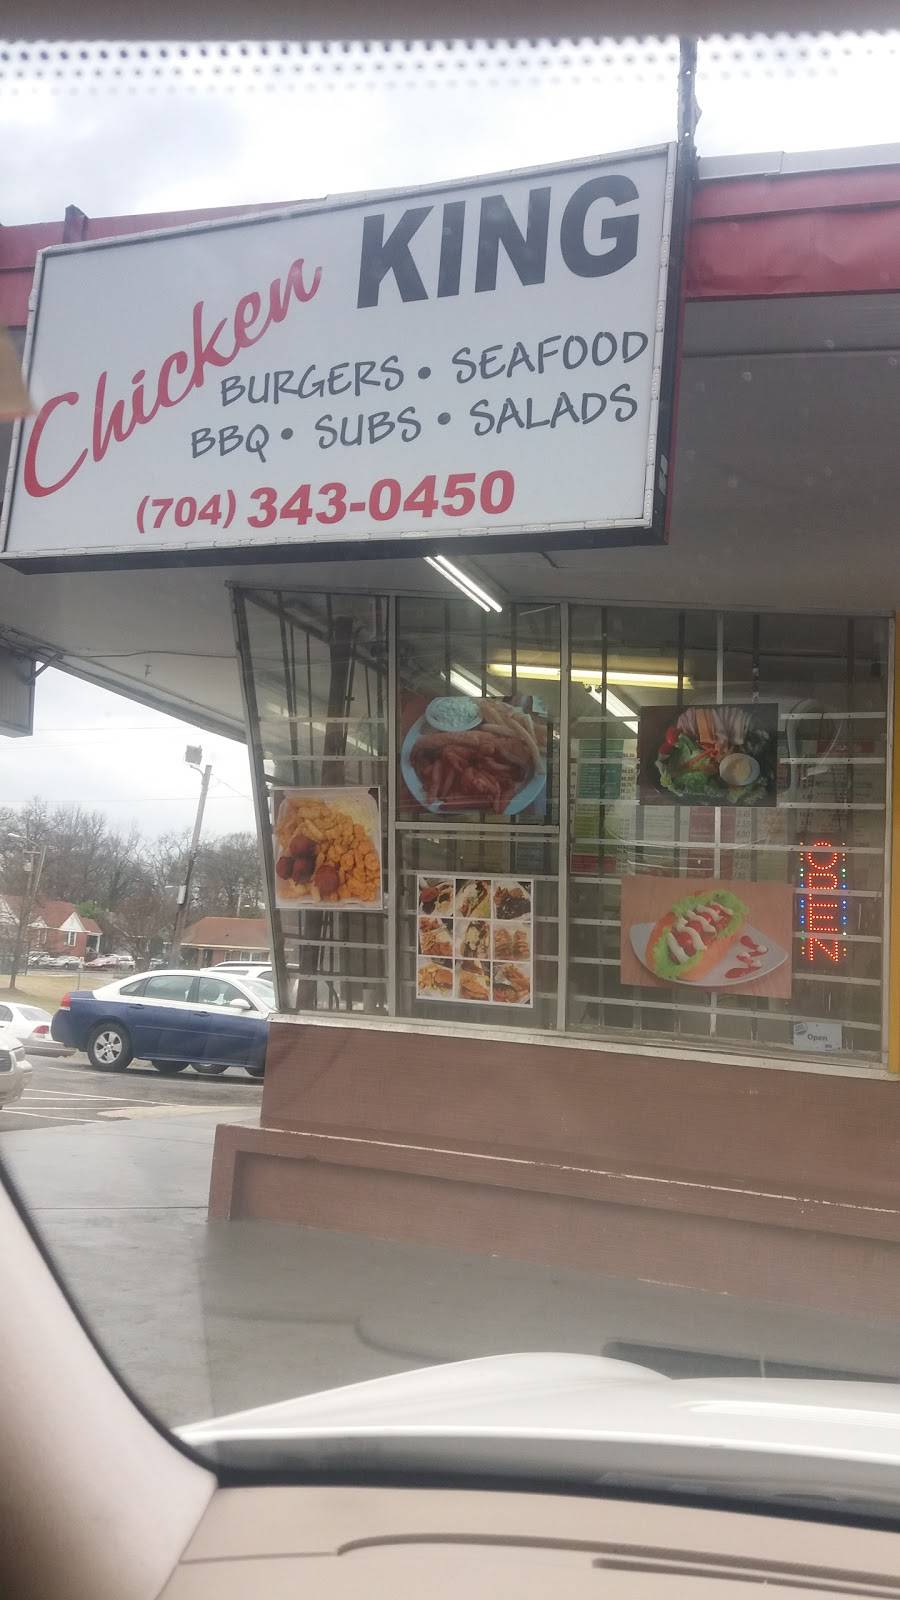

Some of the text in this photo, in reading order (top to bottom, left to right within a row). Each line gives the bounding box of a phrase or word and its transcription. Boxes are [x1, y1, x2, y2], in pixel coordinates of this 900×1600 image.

[23, 174, 640, 498] Chicken KING
[220, 330, 650, 407] BURGERS SEAFOOD
[191, 383, 638, 463] BBQ SUBS SALADS
[136, 470, 514, 532] (704) 343-0450
[807, 841, 839, 962] OPEN
